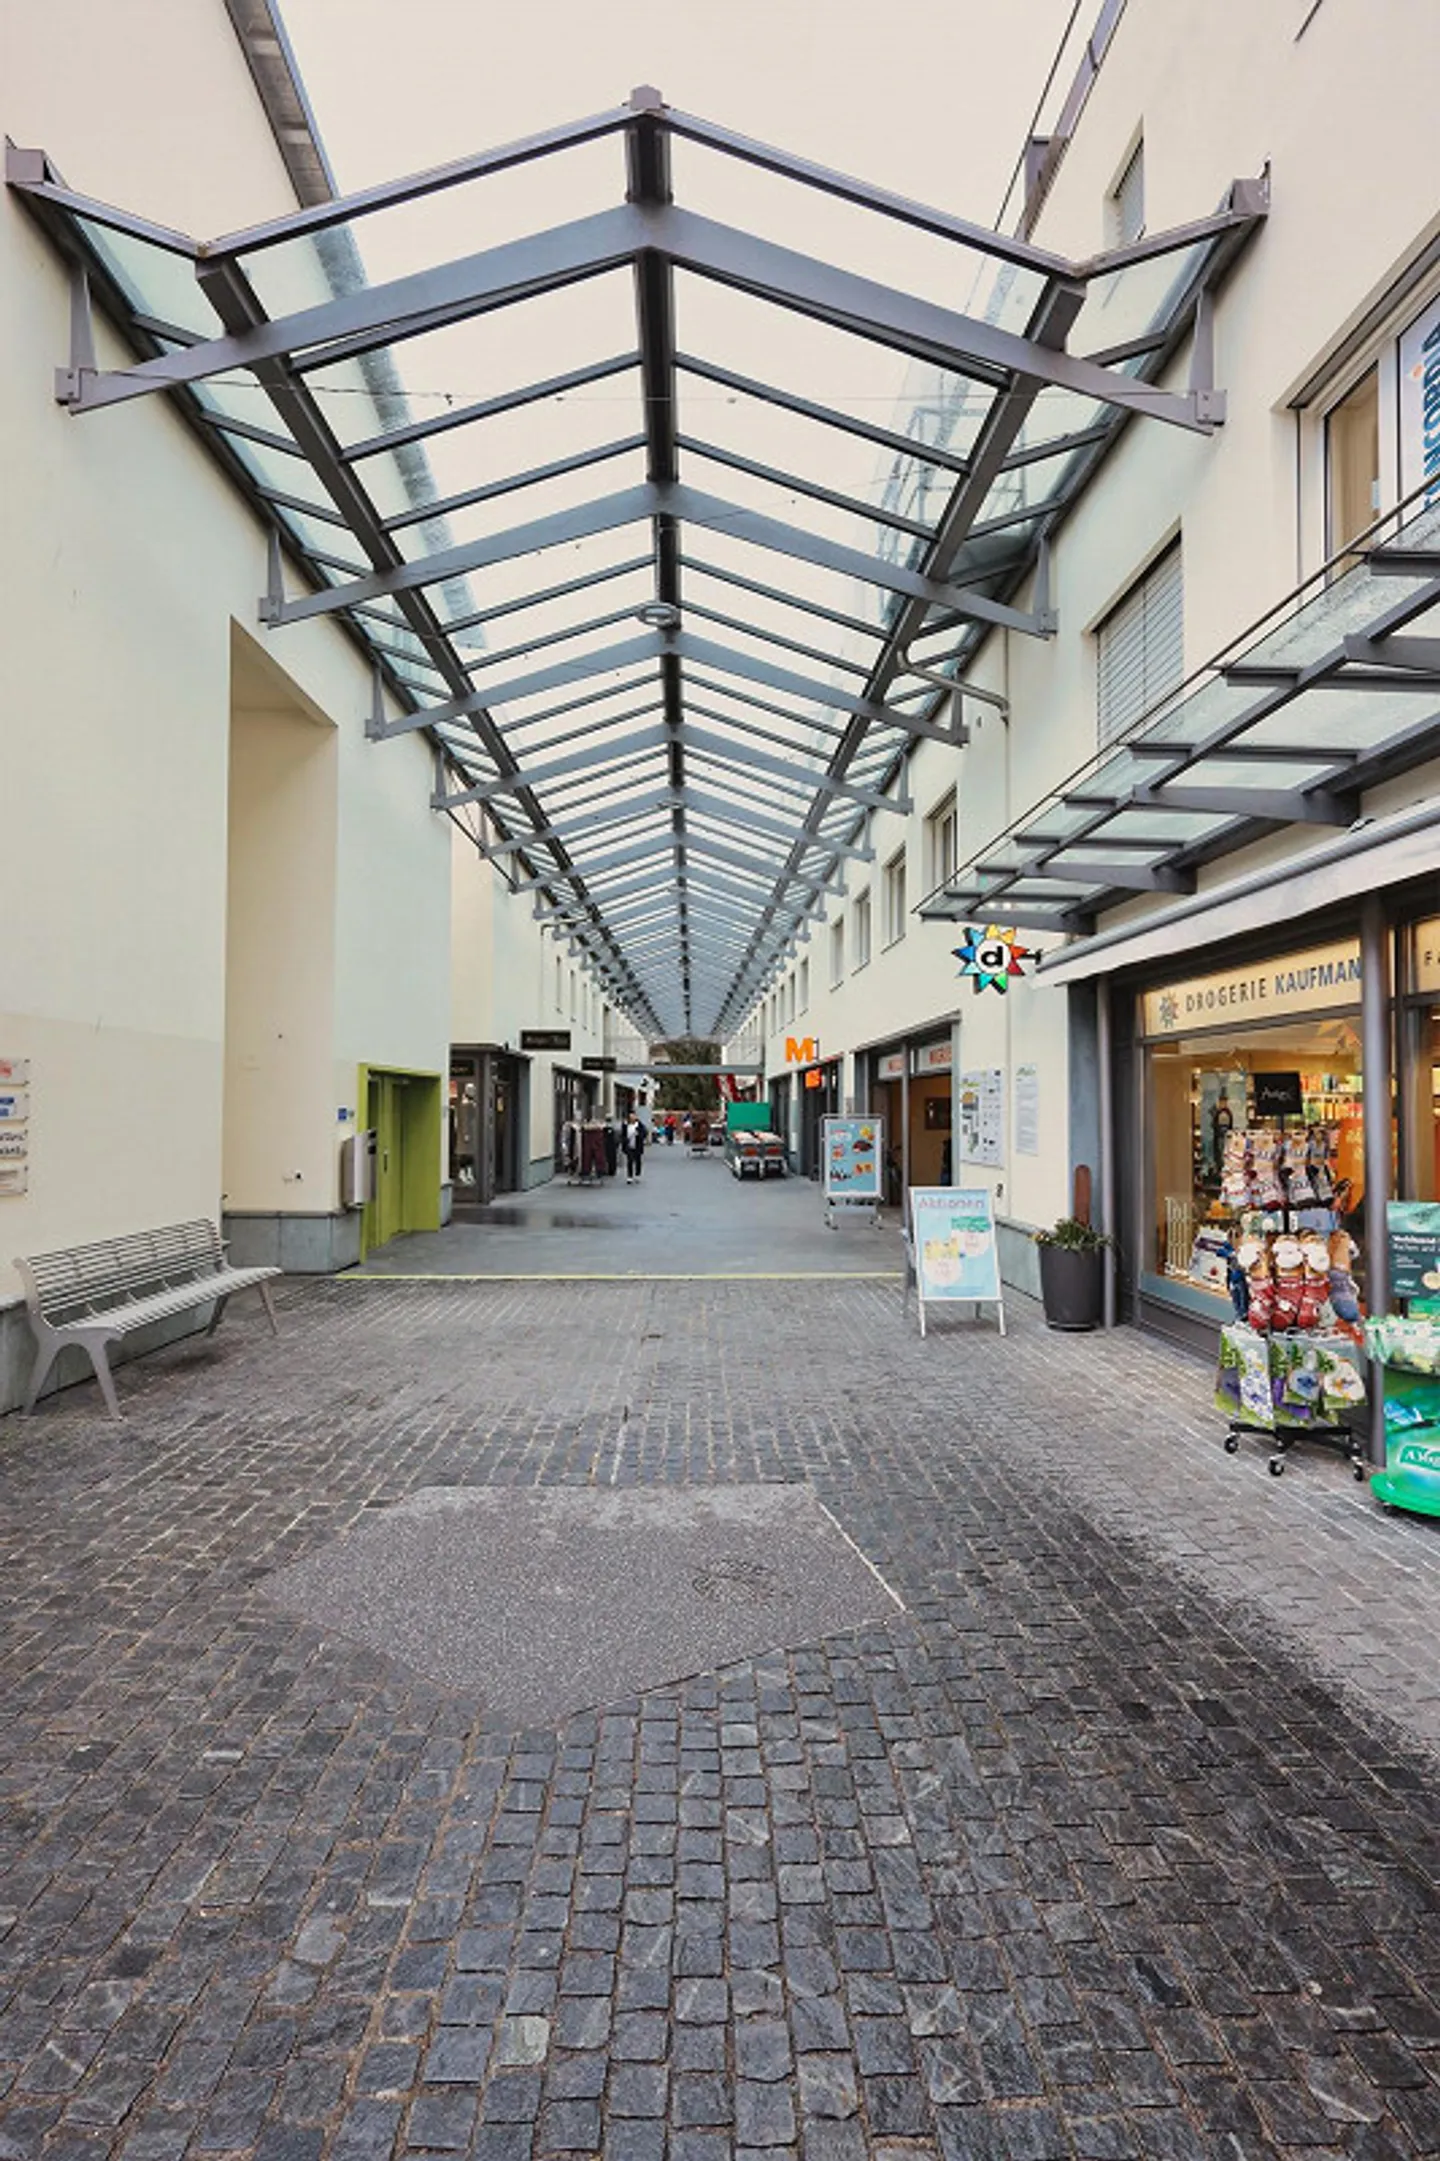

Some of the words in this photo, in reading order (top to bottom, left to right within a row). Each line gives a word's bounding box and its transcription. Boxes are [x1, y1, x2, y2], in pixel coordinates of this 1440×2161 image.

[981, 945, 1003, 967] d
[1185, 977, 1267, 1012] DROGERIE
[785, 1036, 814, 1063] M
